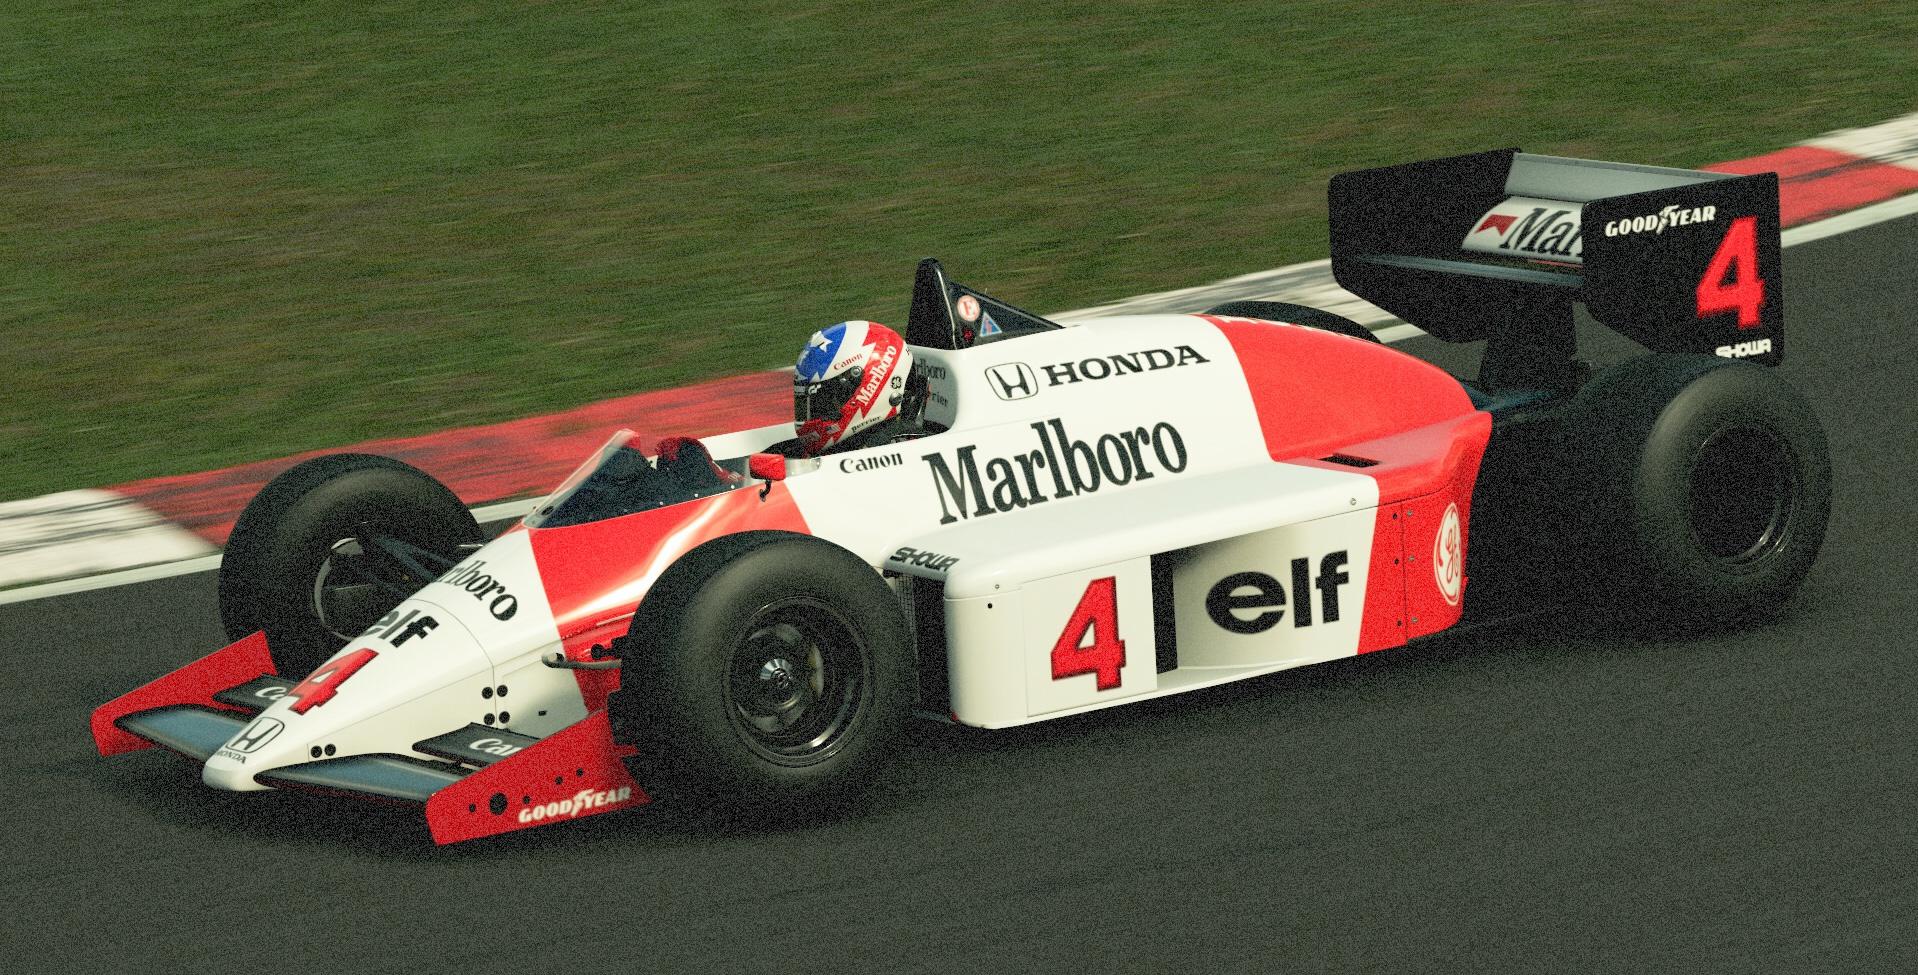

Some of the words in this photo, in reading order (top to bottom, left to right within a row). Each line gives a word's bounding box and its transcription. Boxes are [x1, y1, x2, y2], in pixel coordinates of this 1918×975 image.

[1499, 208, 1583, 257] Mar
[1604, 205, 1716, 239] GOODYEAR
[1696, 215, 1766, 331] 4
[833, 353, 863, 372] Canon
[1041, 345, 1210, 387] HONDA
[1715, 338, 1772, 358] SHOWA
[856, 345, 897, 407] Marlboro
[839, 451, 904, 474] Canon
[922, 417, 1188, 526] Marlboro
[889, 546, 960, 572] SHOWA
[1204, 549, 1350, 635] elf
[362, 609, 440, 648] elf
[1050, 574, 1127, 693] 4
[286, 647, 380, 716] 4
[518, 788, 631, 823] GOODYEAR
